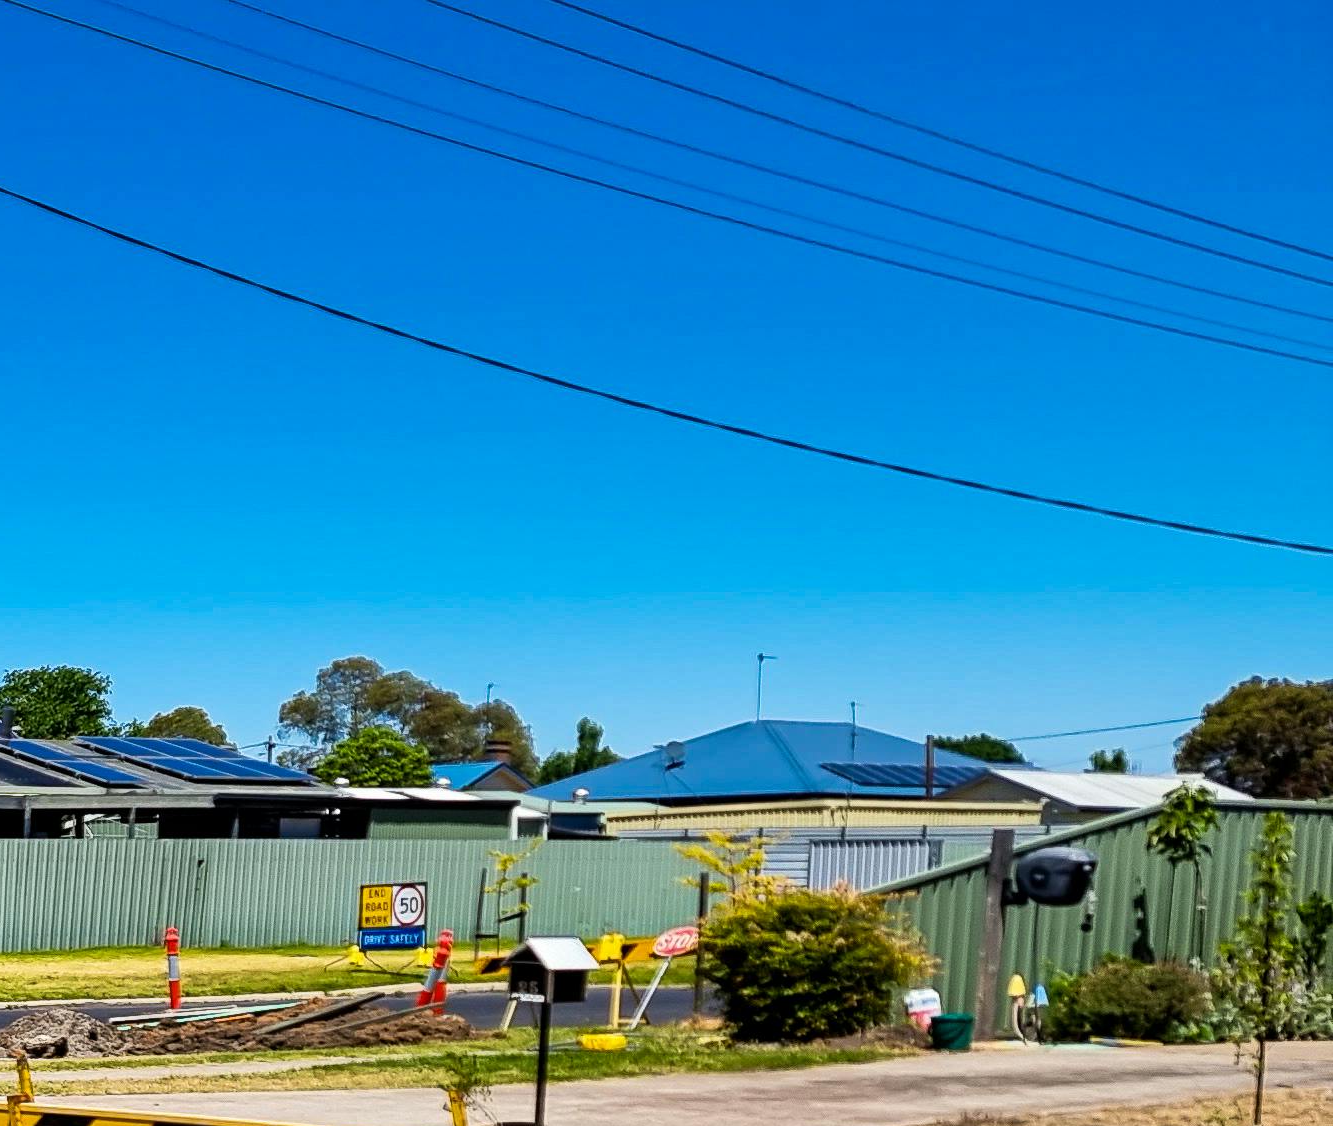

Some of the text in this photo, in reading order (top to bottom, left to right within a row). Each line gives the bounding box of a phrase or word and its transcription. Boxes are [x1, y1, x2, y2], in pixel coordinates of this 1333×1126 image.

[369, 889, 386, 899] END
[365, 901, 389, 912] ROAD
[400, 897, 419, 914] 50
[365, 915, 389, 925] WORK
[390, 933, 419, 944] SAFELY
